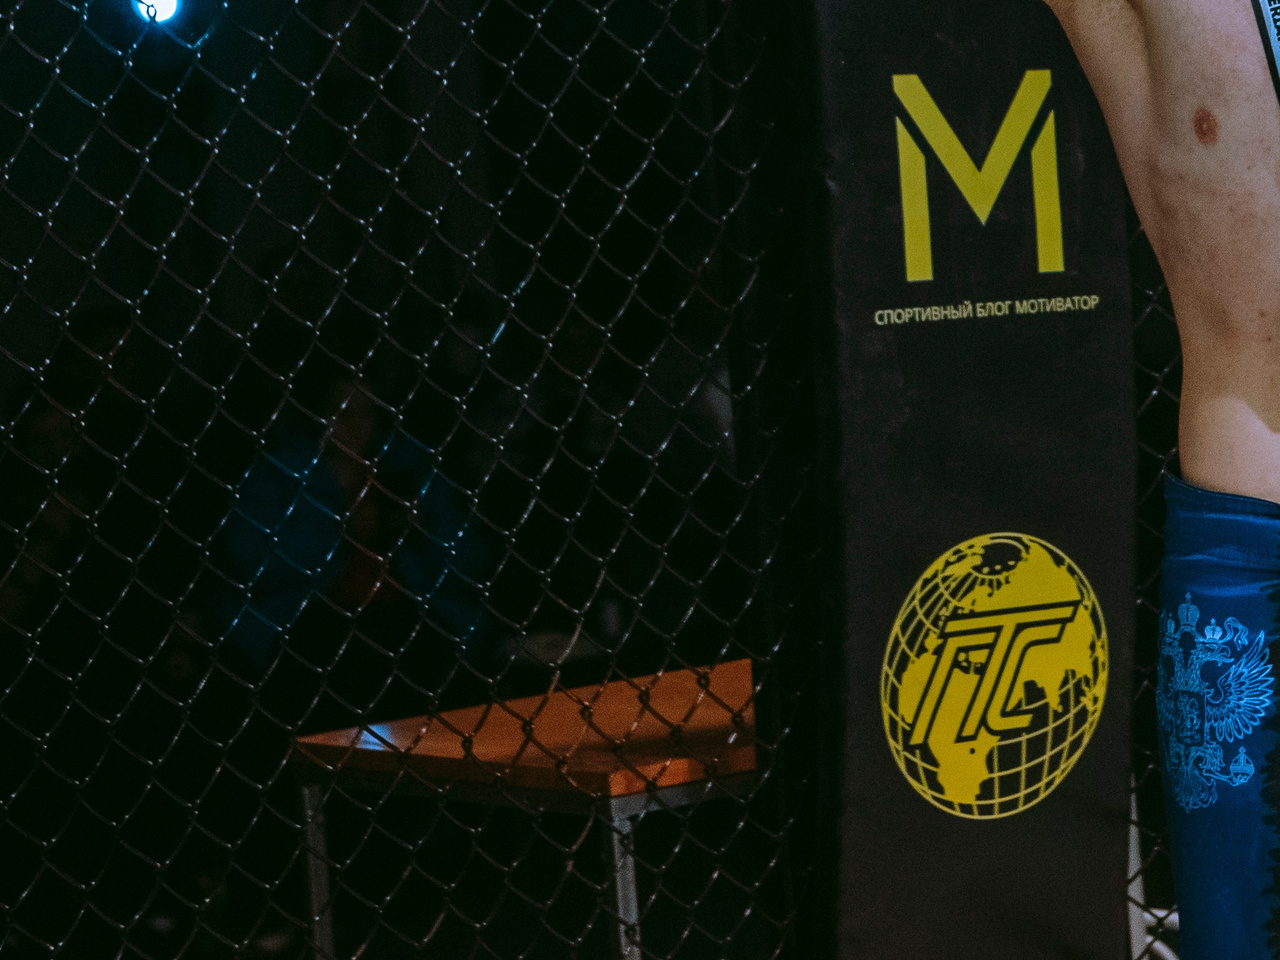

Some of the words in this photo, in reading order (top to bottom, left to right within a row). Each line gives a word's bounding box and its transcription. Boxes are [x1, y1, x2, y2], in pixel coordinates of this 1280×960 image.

[874, 300, 973, 325] СПОРТИВНЫЙ
[976, 300, 1013, 318] БЛОГ
[1015, 295, 1099, 315] МОТИВАТОР
